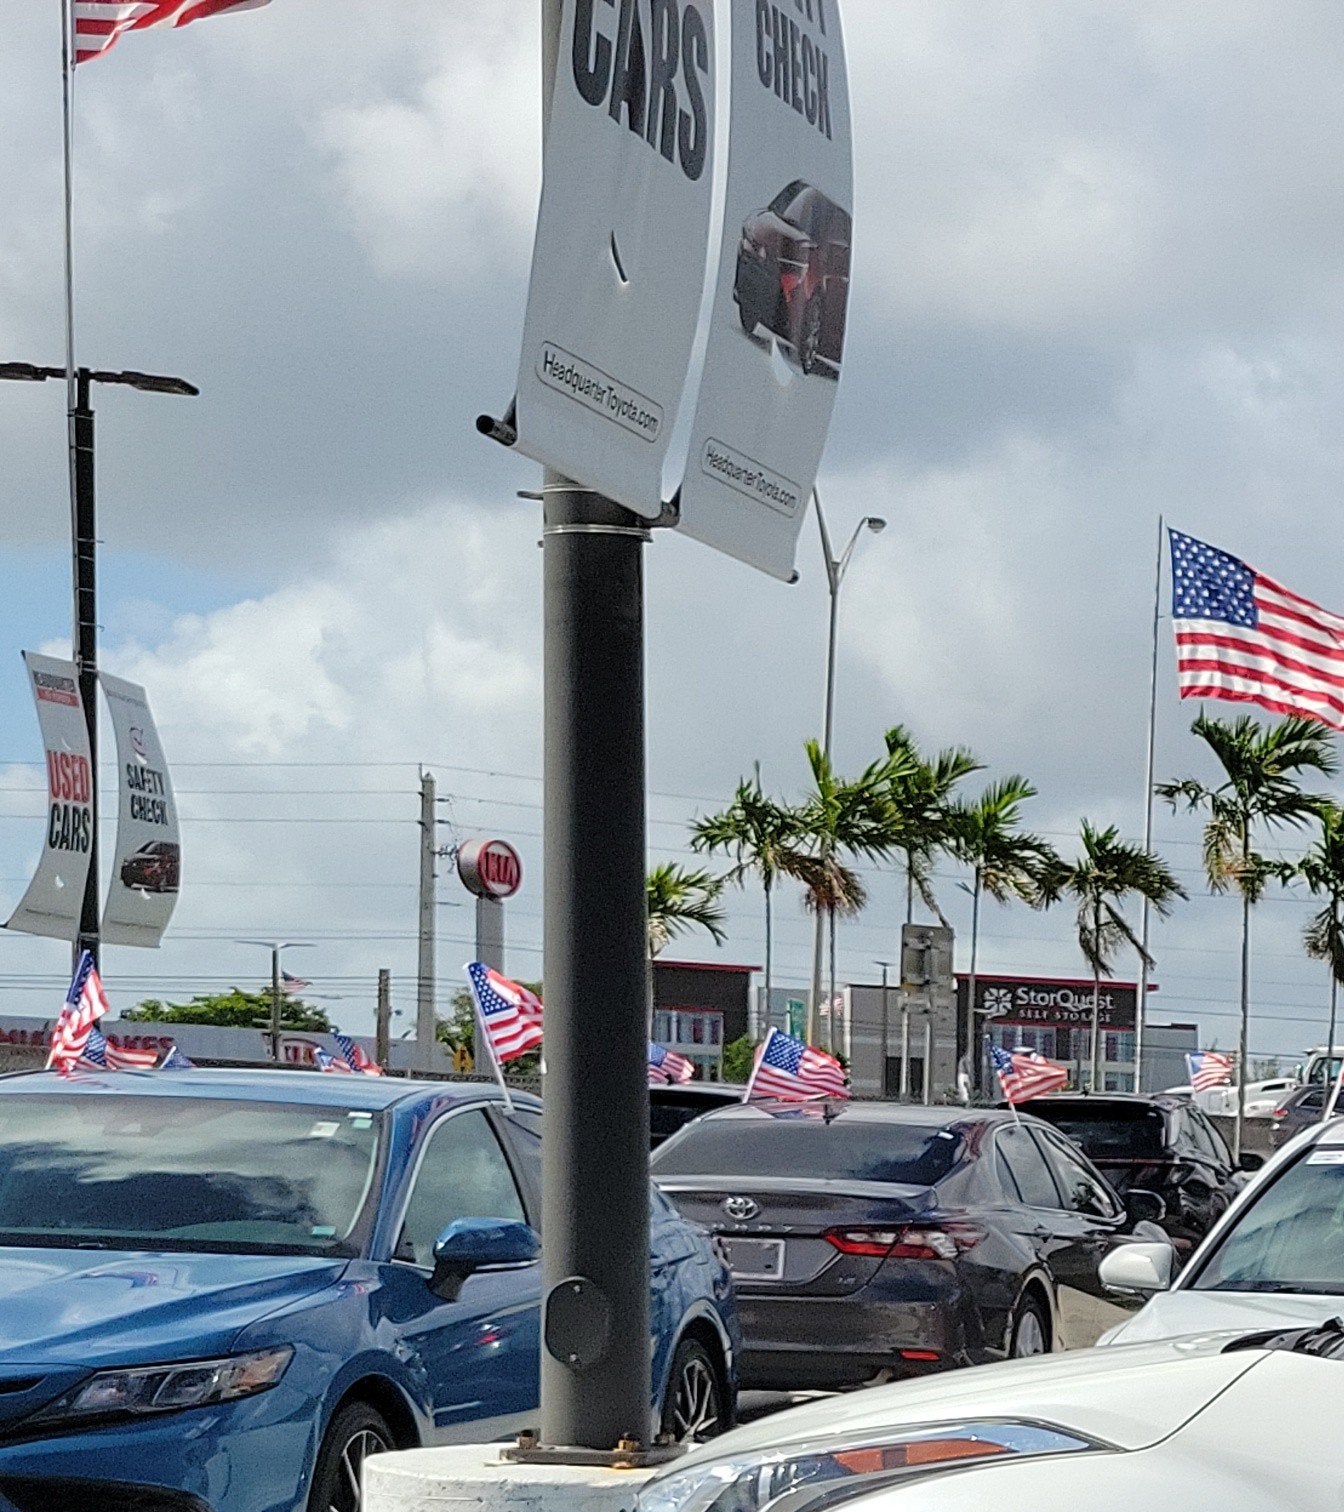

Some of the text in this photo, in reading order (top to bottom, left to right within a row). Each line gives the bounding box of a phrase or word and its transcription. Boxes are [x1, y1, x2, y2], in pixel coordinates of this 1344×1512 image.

[572, 0, 708, 181] CARS
[754, 0, 832, 141] CHECK
[543, 350, 659, 434] HeadquarterToyota.com
[47, 750, 91, 804] USED
[125, 762, 165, 796] SAFETY
[48, 803, 91, 853] CARS
[130, 793, 168, 826] CHECK
[1015, 986, 1115, 1012] StorQuest
[1018, 1009, 1047, 1020] SELF
